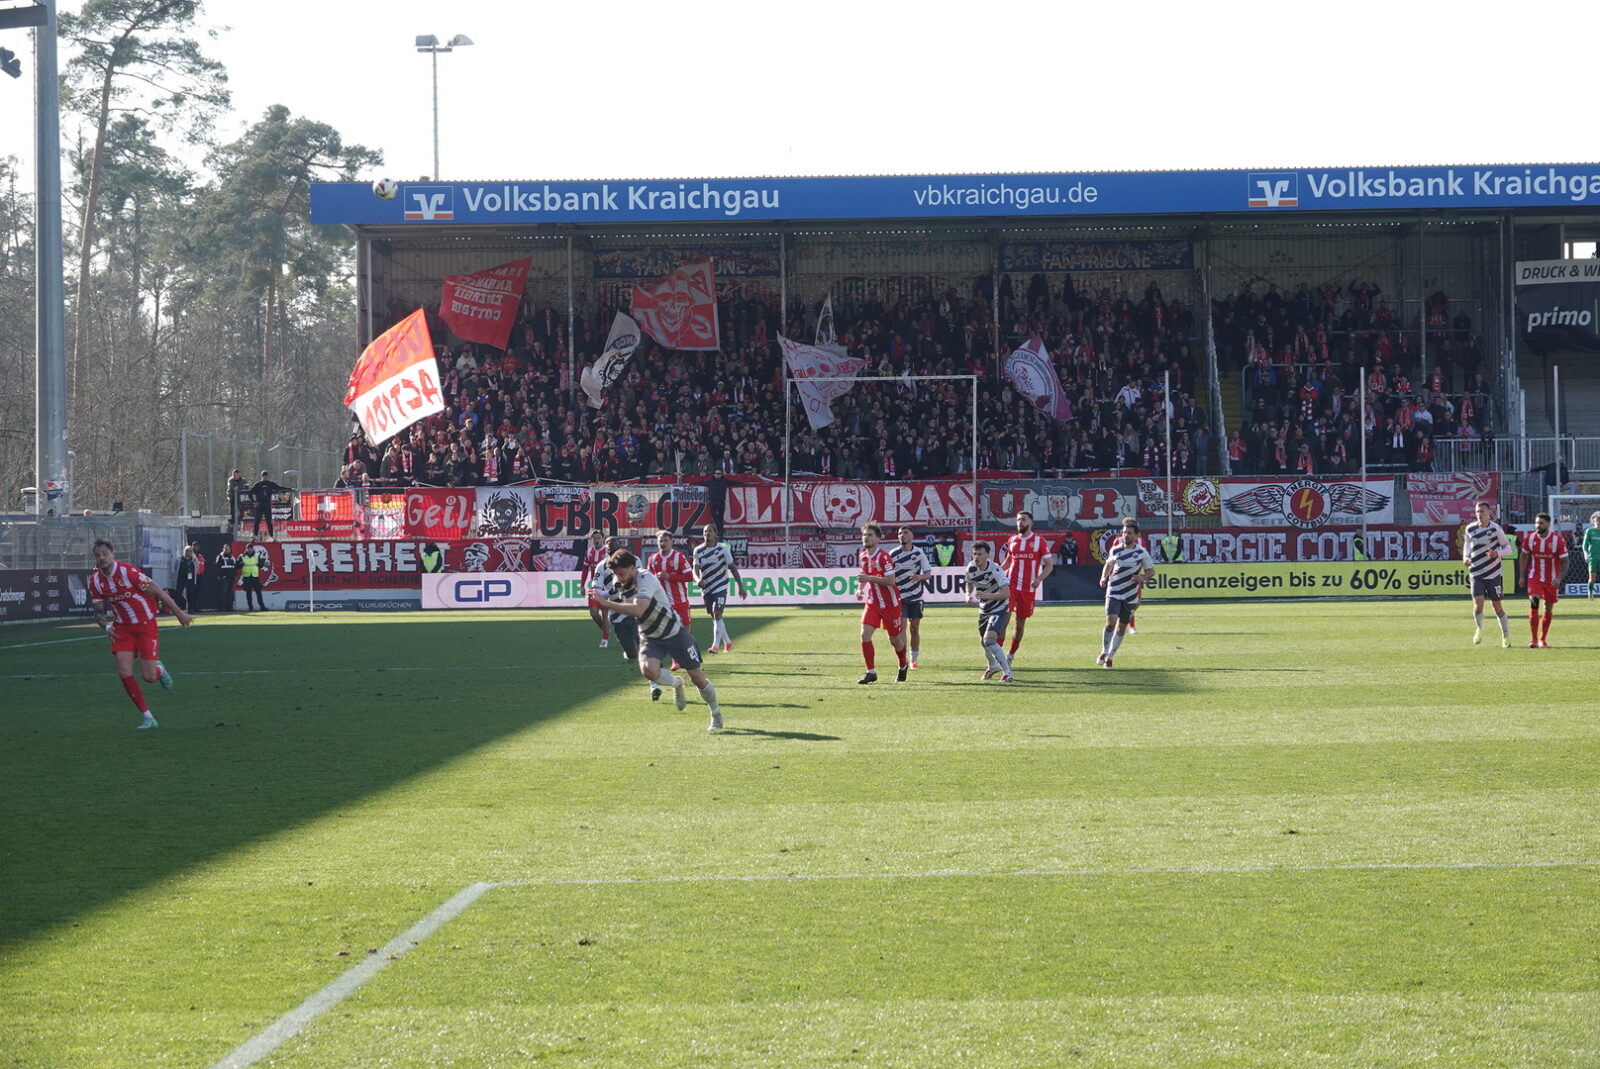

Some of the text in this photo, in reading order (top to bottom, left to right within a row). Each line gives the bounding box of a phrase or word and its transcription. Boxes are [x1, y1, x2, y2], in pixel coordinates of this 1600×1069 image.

[1307, 170, 1464, 198] Volksbank
[463, 183, 780, 216] Volksbank Kraichgau
[913, 182, 1098, 209] vbkraichgau.de
[1522, 265, 1567, 280] DRUCK
[1569, 265, 1580, 278] &
[1527, 306, 1592, 333] primo
[1140, 483, 1157, 492] RED
[1286, 480, 1328, 497] ENERGIE
[407, 493, 469, 529] Geil
[1146, 503, 1182, 512] COTTUS
[926, 517, 974, 527] ENERGIE
[1250, 518, 1285, 526] SEIT
[1287, 512, 1328, 529] COTTBUS
[1145, 572, 1283, 592] ellenanzeigen
[1290, 571, 1316, 587] bis
[1322, 575, 1343, 587] zu
[1350, 568, 1402, 590] 60%
[455, 579, 512, 602] GP
